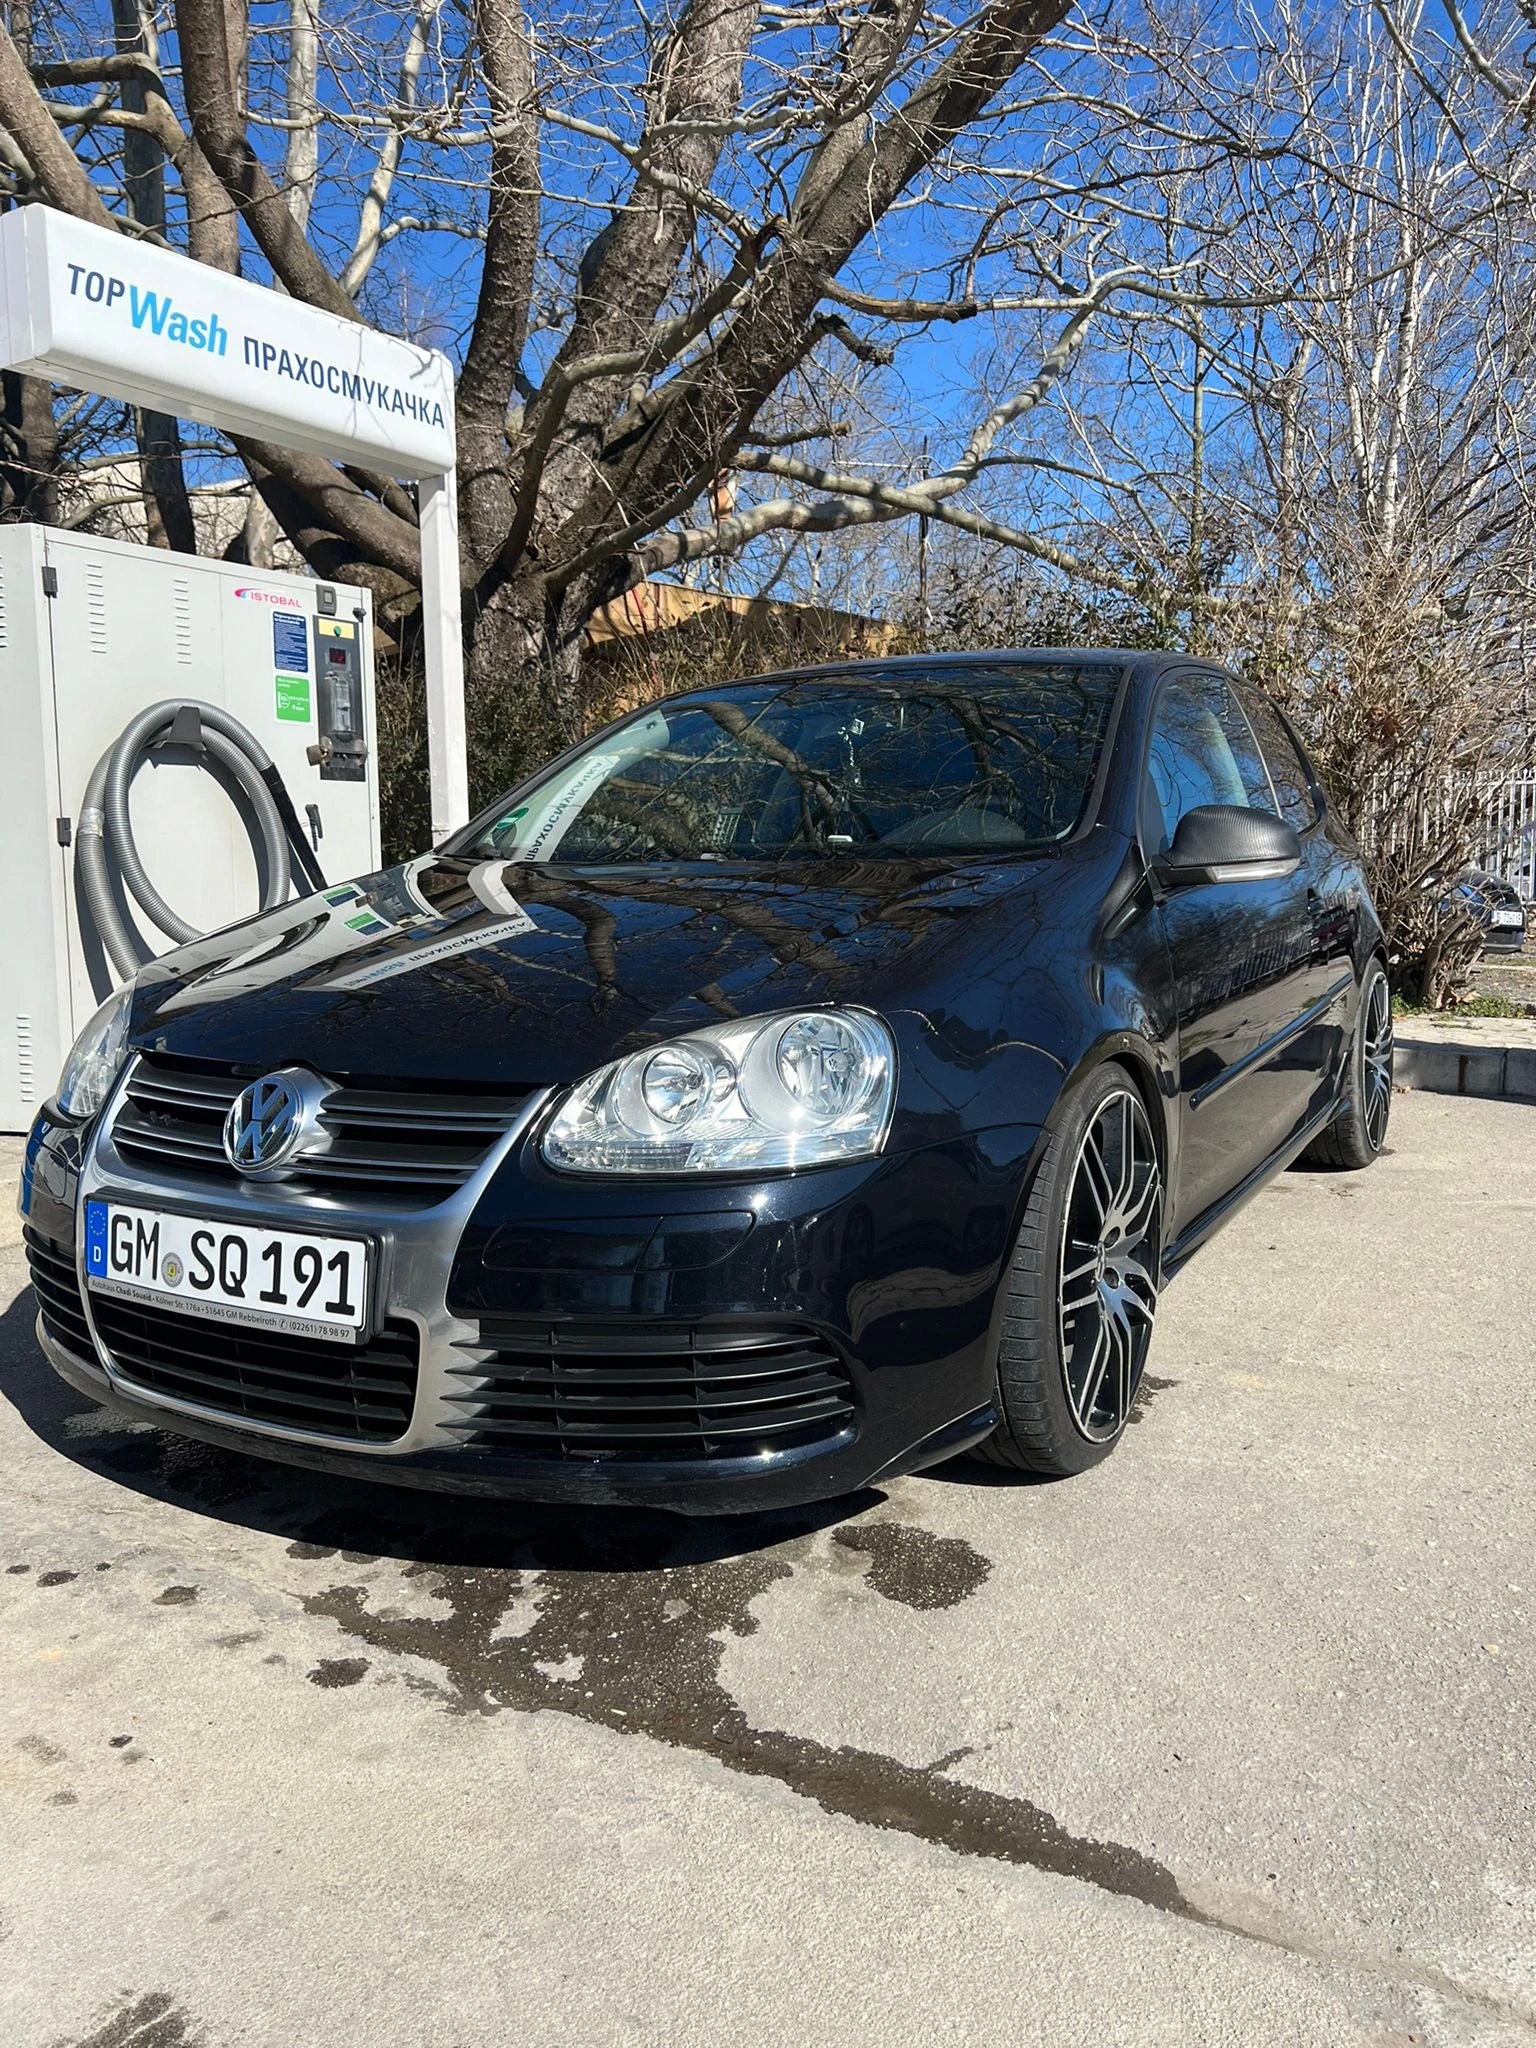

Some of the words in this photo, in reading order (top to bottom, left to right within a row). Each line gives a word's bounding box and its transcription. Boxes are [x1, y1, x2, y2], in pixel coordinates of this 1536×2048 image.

[243, 335, 446, 429] ПРАХОСМУКАЧКА
[250, 592, 302, 608] ISTOBAL
[93, 1245, 102, 1263] D
[110, 1213, 160, 1281] GM
[188, 1230, 248, 1298] SQ
[259, 1240, 356, 1316] 191
[92, 1279, 115, 1292] Autohaus
[116, 1285, 132, 1296] Chadi
[156, 1296, 173, 1307] Kölner
[174, 1300, 185, 1310] Str.
[186, 1303, 201, 1312] 176a
[205, 1306, 225, 1317] 51645
[226, 1310, 238, 1319] GM
[239, 1312, 277, 1327] Rebbelroth
[289, 1322, 317, 1334] (02261)
[318, 1326, 328, 1336] 78
[329, 1327, 339, 1337] 98
[340, 1329, 350, 1339] 97
